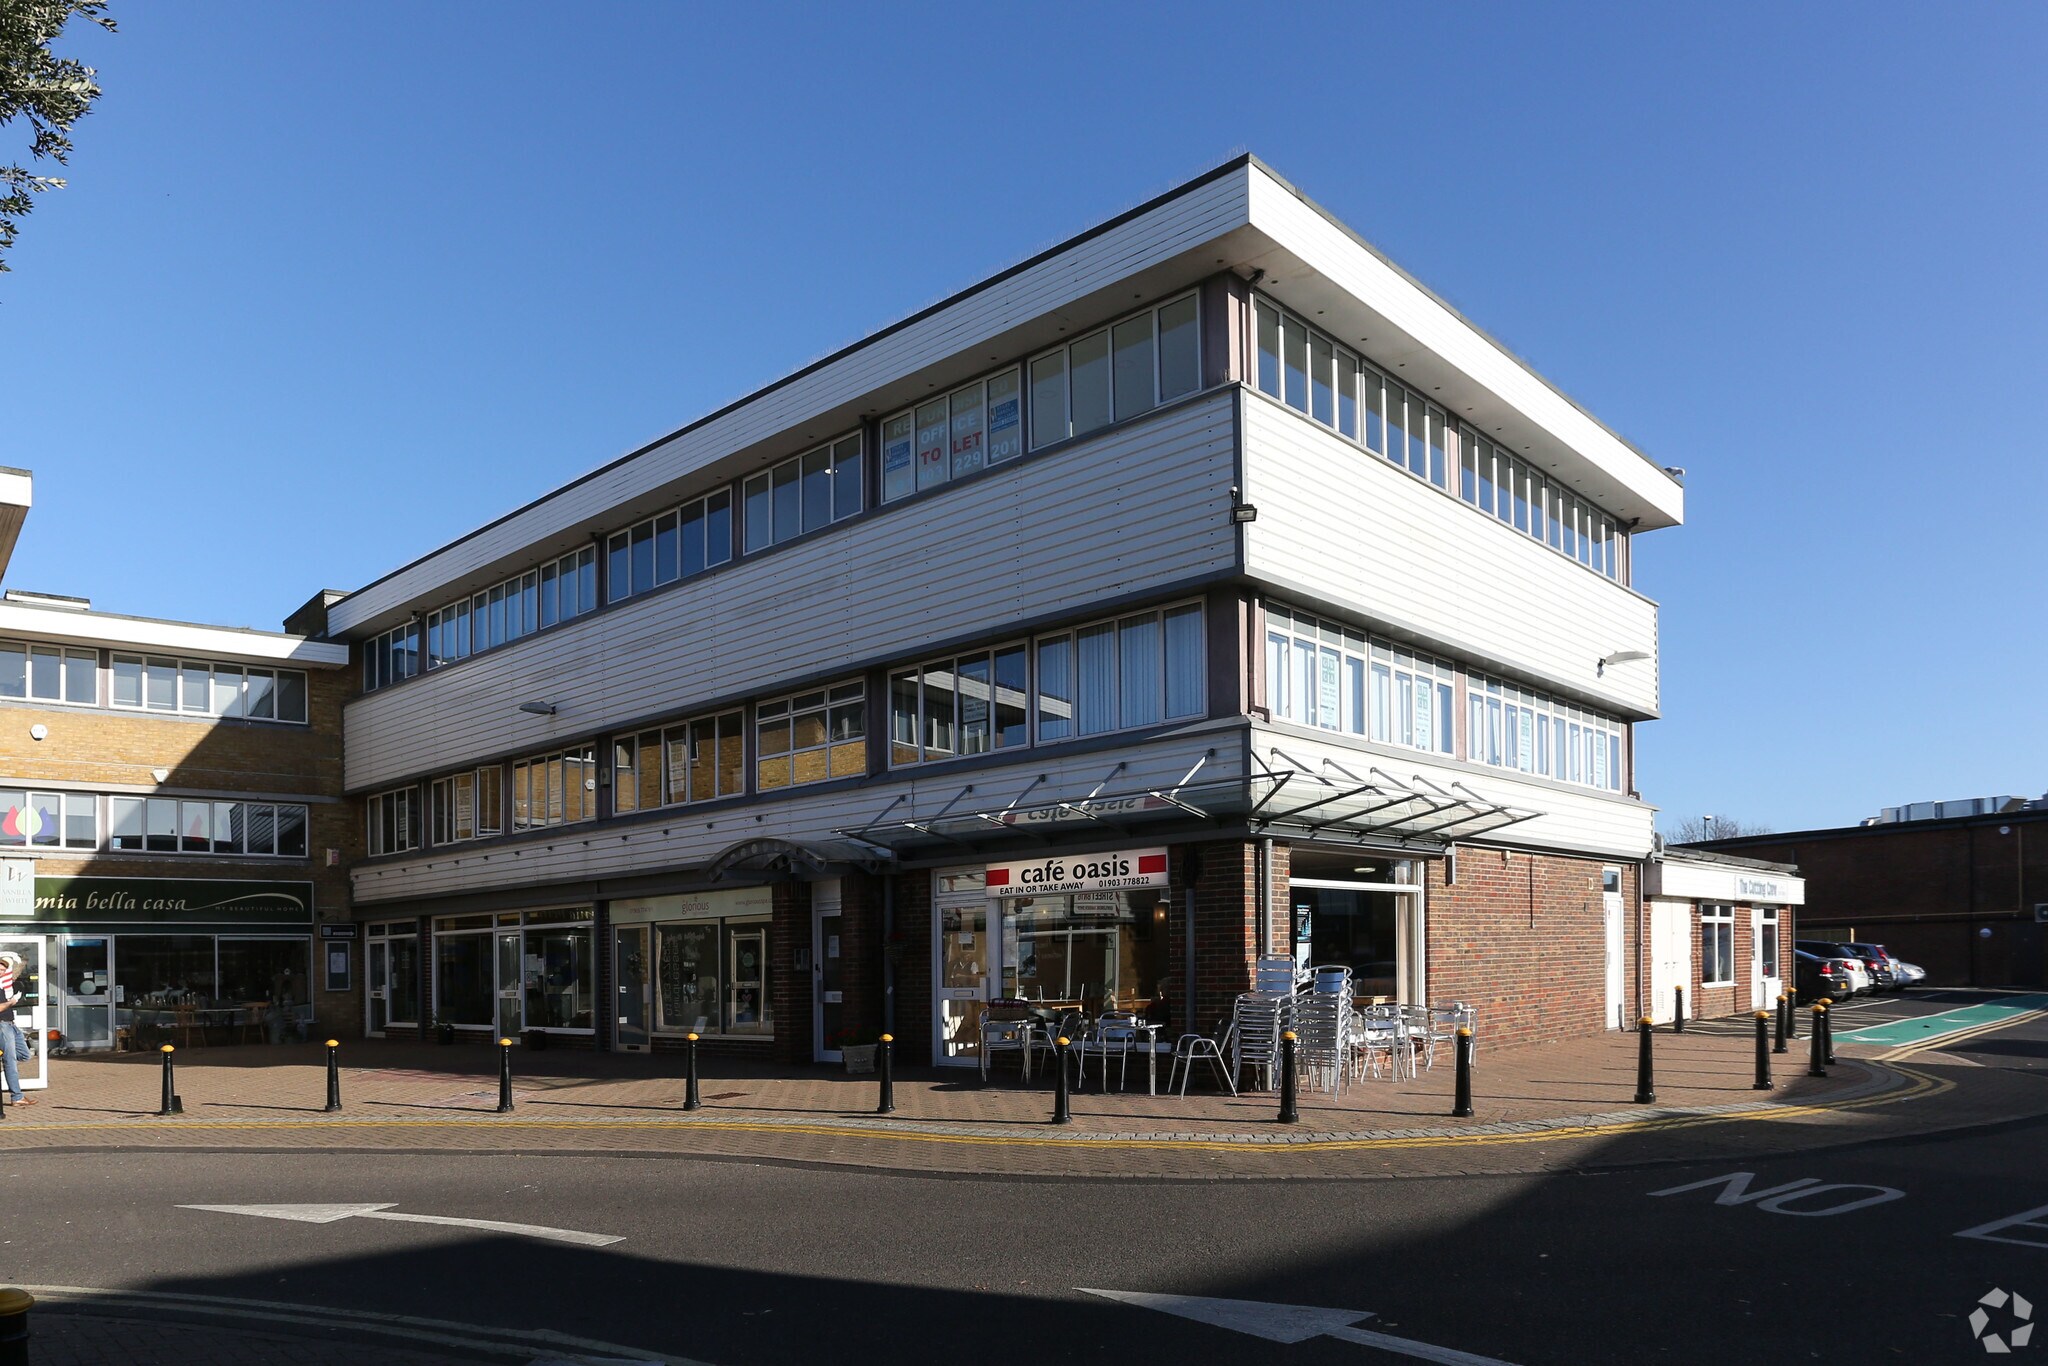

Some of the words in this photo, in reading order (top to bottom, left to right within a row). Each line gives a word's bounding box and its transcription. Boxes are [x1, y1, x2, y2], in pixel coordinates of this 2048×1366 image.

[921, 410, 977, 444] OFFICE
[921, 447, 942, 465] TO
[953, 431, 982, 454] LET
[955, 452, 980, 473] 229
[991, 438, 1018, 459] 201
[1021, 859, 1065, 884] café
[1072, 854, 1129, 880] oasis
[1099, 879, 1120, 888] 01903
[1123, 876, 1150, 886] 778822
[34, 893, 77, 910] mia
[86, 891, 135, 910] bella
[143, 899, 188, 911] casa
[1000, 887, 1014, 895] EAT
[1025, 885, 1037, 893] OR
[1038, 884, 1058, 892] TAKE
[1060, 882, 1084, 891] AWAY
[681, 901, 710, 915] glorious
[1646, 1172, 1906, 1217] NO
